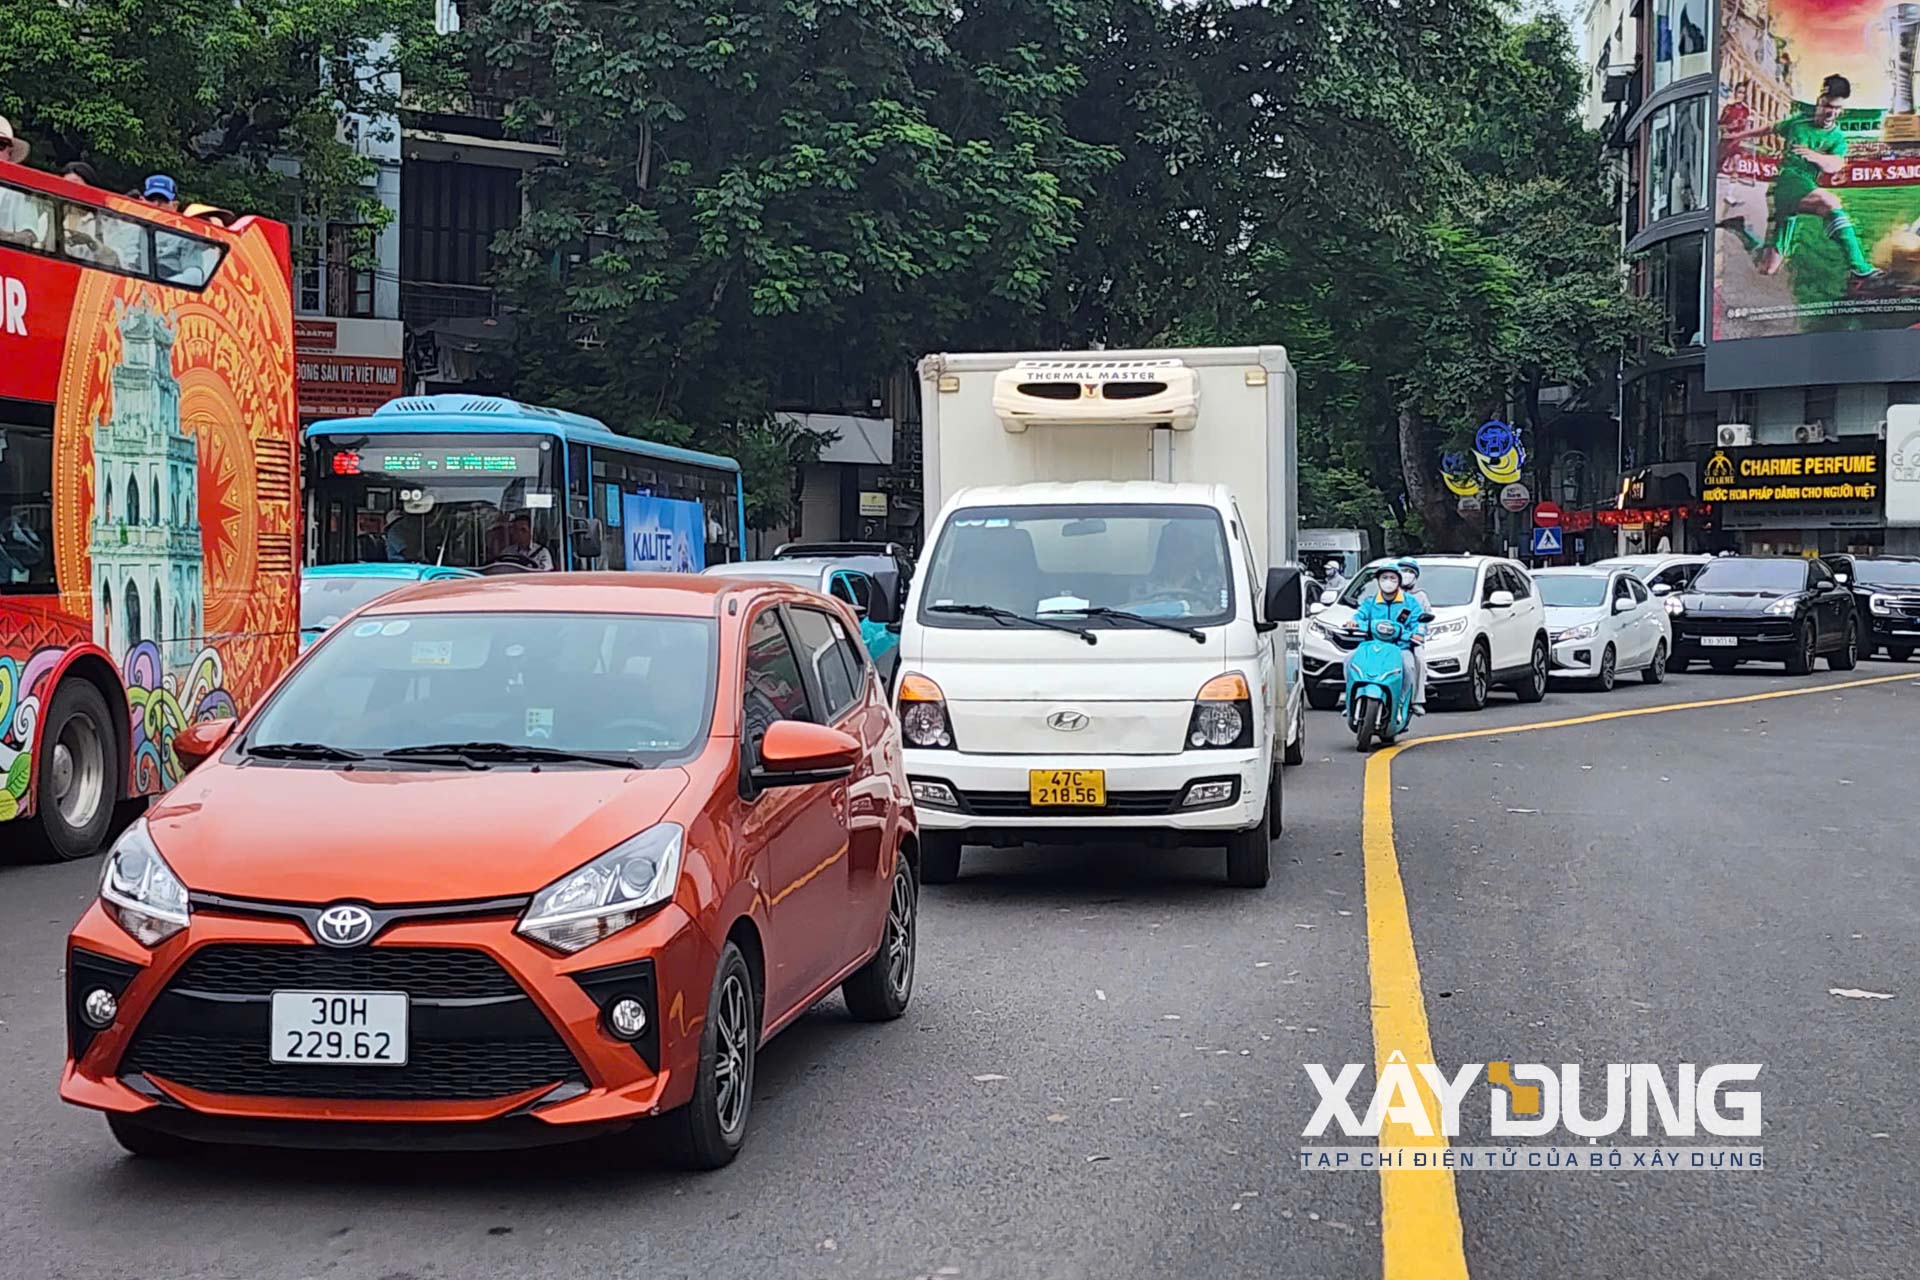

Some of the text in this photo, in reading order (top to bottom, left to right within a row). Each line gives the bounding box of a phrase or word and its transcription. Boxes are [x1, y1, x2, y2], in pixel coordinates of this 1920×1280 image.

[1737, 159, 1760, 176] BIA
[1852, 167, 1882, 181] BIA
[0, 275, 28, 336] R
[376, 366, 397, 385] NAM
[1028, 370, 1156, 380] THERMAL MASTER
[1741, 455, 1877, 477] CHARME PERFUME
[1749, 485, 1774, 500] PHÁP
[1801, 486, 1823, 499] CHO
[1855, 482, 1877, 500] VIỆT
[1051, 772, 1083, 786] 47C
[1039, 788, 1097, 803] 218.56
[311, 997, 367, 1026] 30H
[286, 1030, 391, 1060] 229.62
